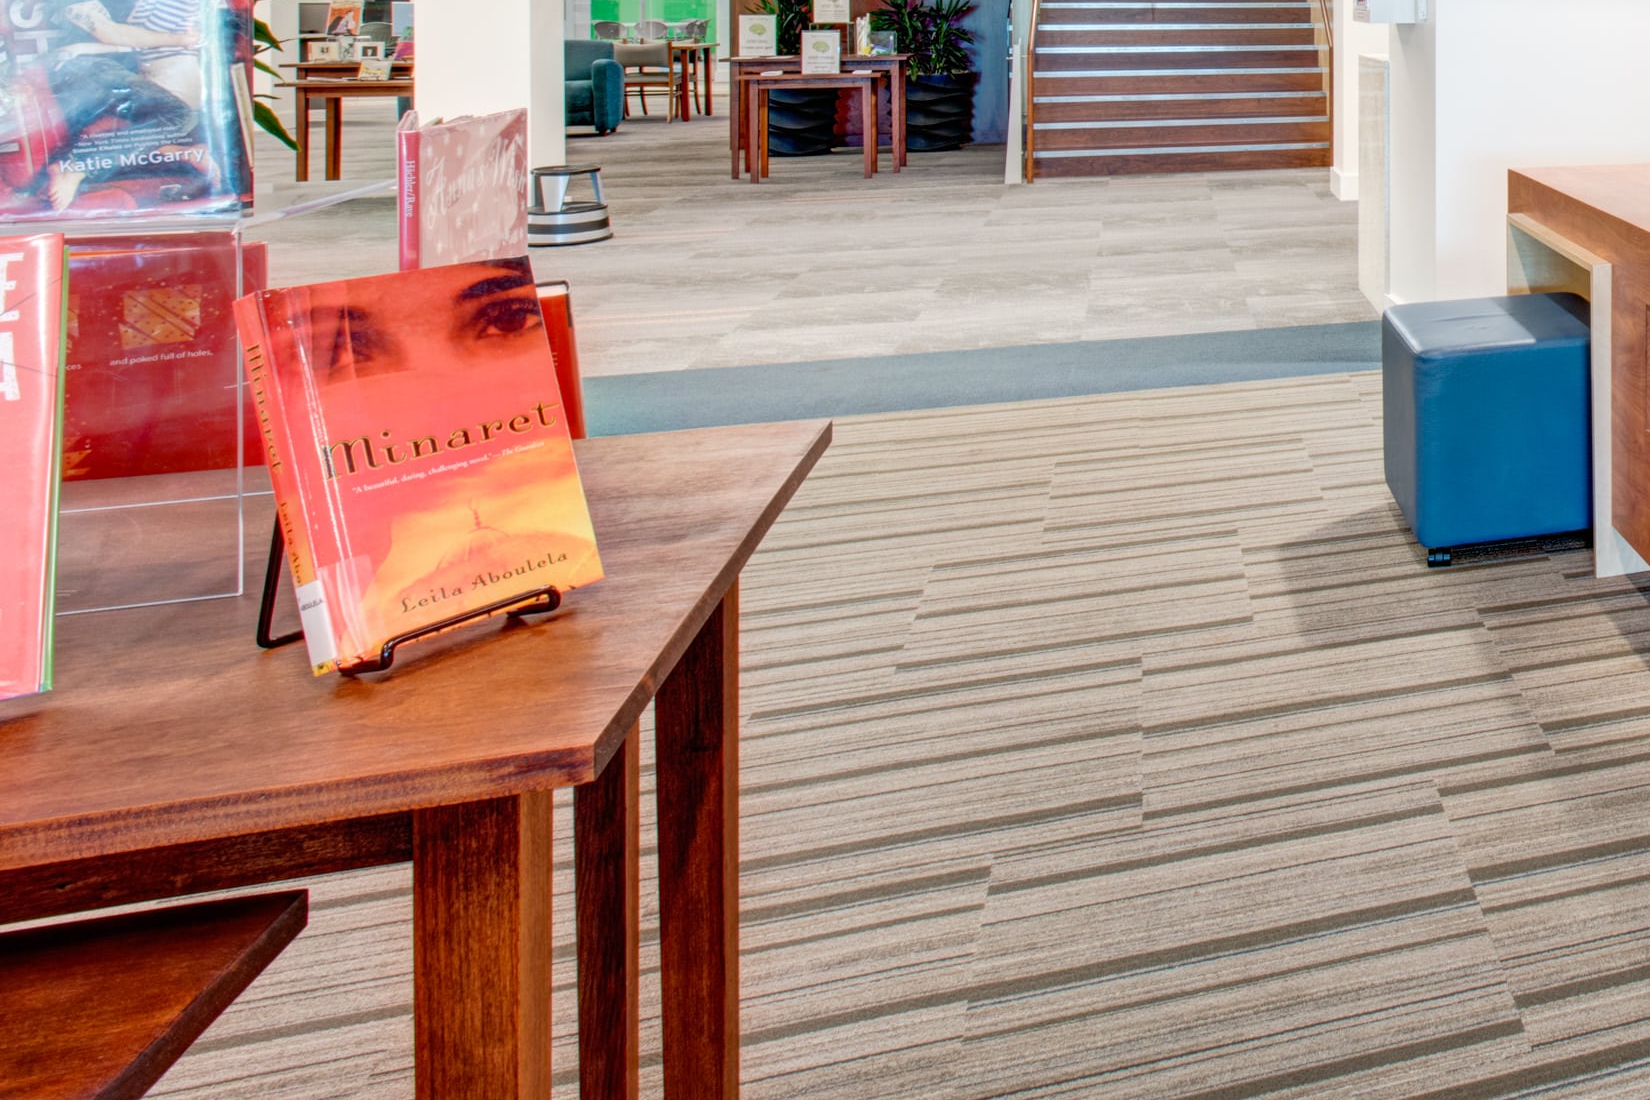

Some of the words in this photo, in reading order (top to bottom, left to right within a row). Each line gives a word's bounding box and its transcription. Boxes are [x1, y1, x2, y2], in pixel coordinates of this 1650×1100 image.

[59, 155, 113, 173] Katie
[119, 147, 205, 168] McGarry
[109, 357, 128, 366] and
[130, 354, 158, 365] poked
[160, 351, 175, 360] full
[176, 350, 187, 359] of
[322, 400, 559, 480] Minaret
[428, 460, 468, 476] challenging
[400, 586, 463, 613] Leila
[471, 551, 568, 592] Aboulela
